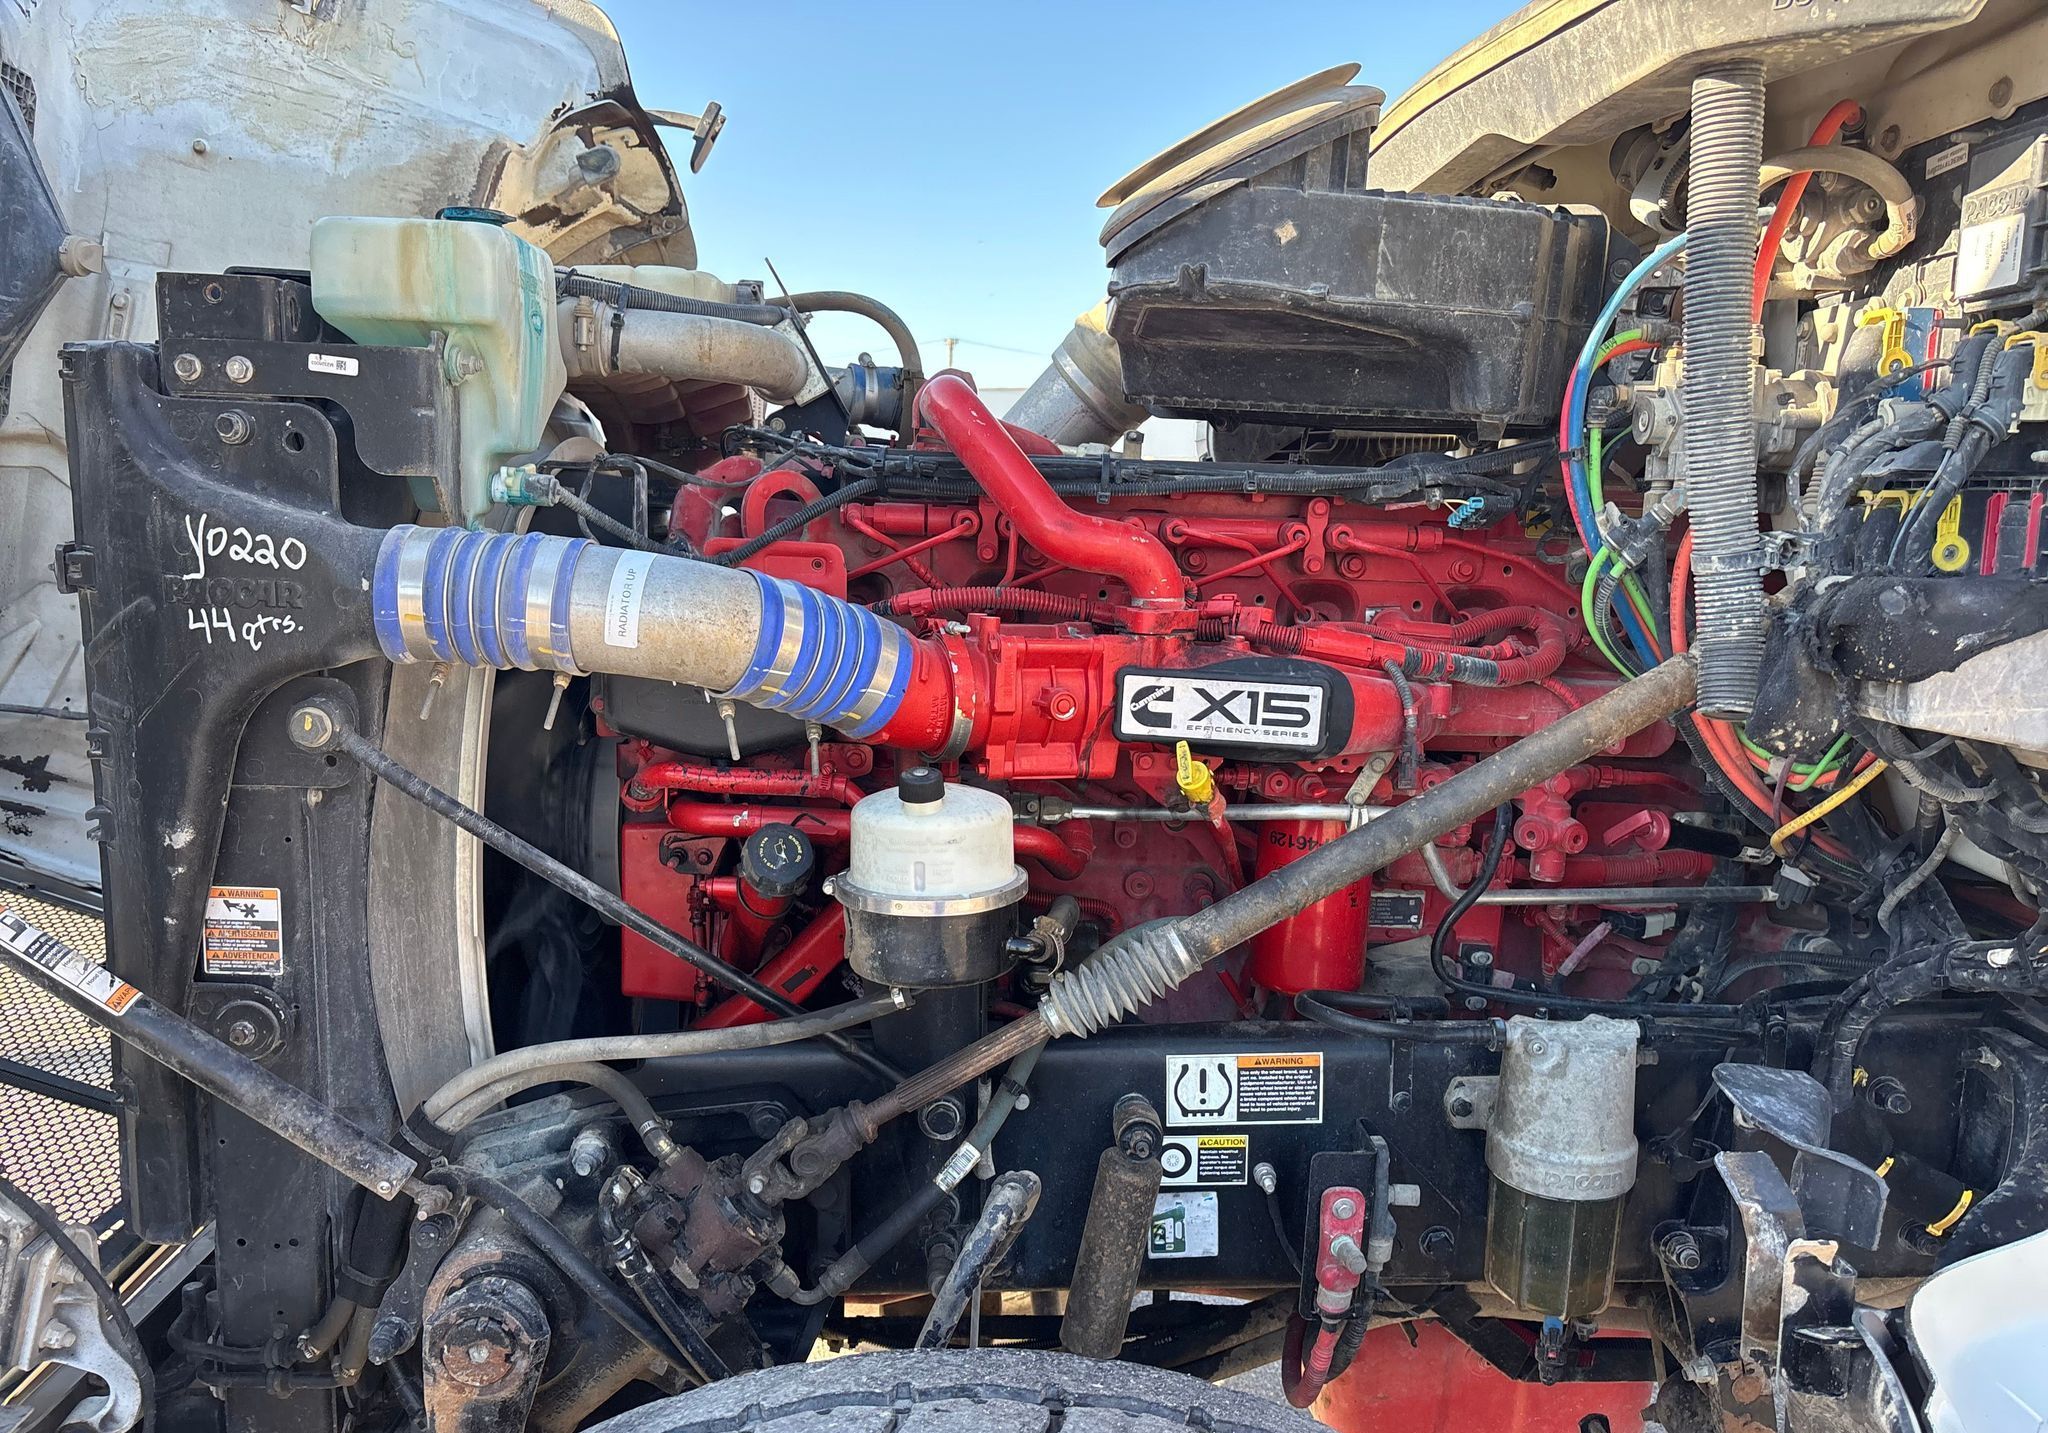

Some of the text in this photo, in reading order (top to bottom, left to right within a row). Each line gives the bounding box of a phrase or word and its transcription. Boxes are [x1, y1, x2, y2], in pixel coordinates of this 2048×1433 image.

[1966, 186, 2030, 223] PACCAR
[618, 568, 636, 637] RADIATOR UP
[188, 607, 236, 644] 44
[1130, 686, 1170, 711] Cummins
[1188, 686, 1310, 728] X15
[1186, 725, 1308, 738] EFFICIENCY SERIES
[1270, 831, 1320, 850] 46129
